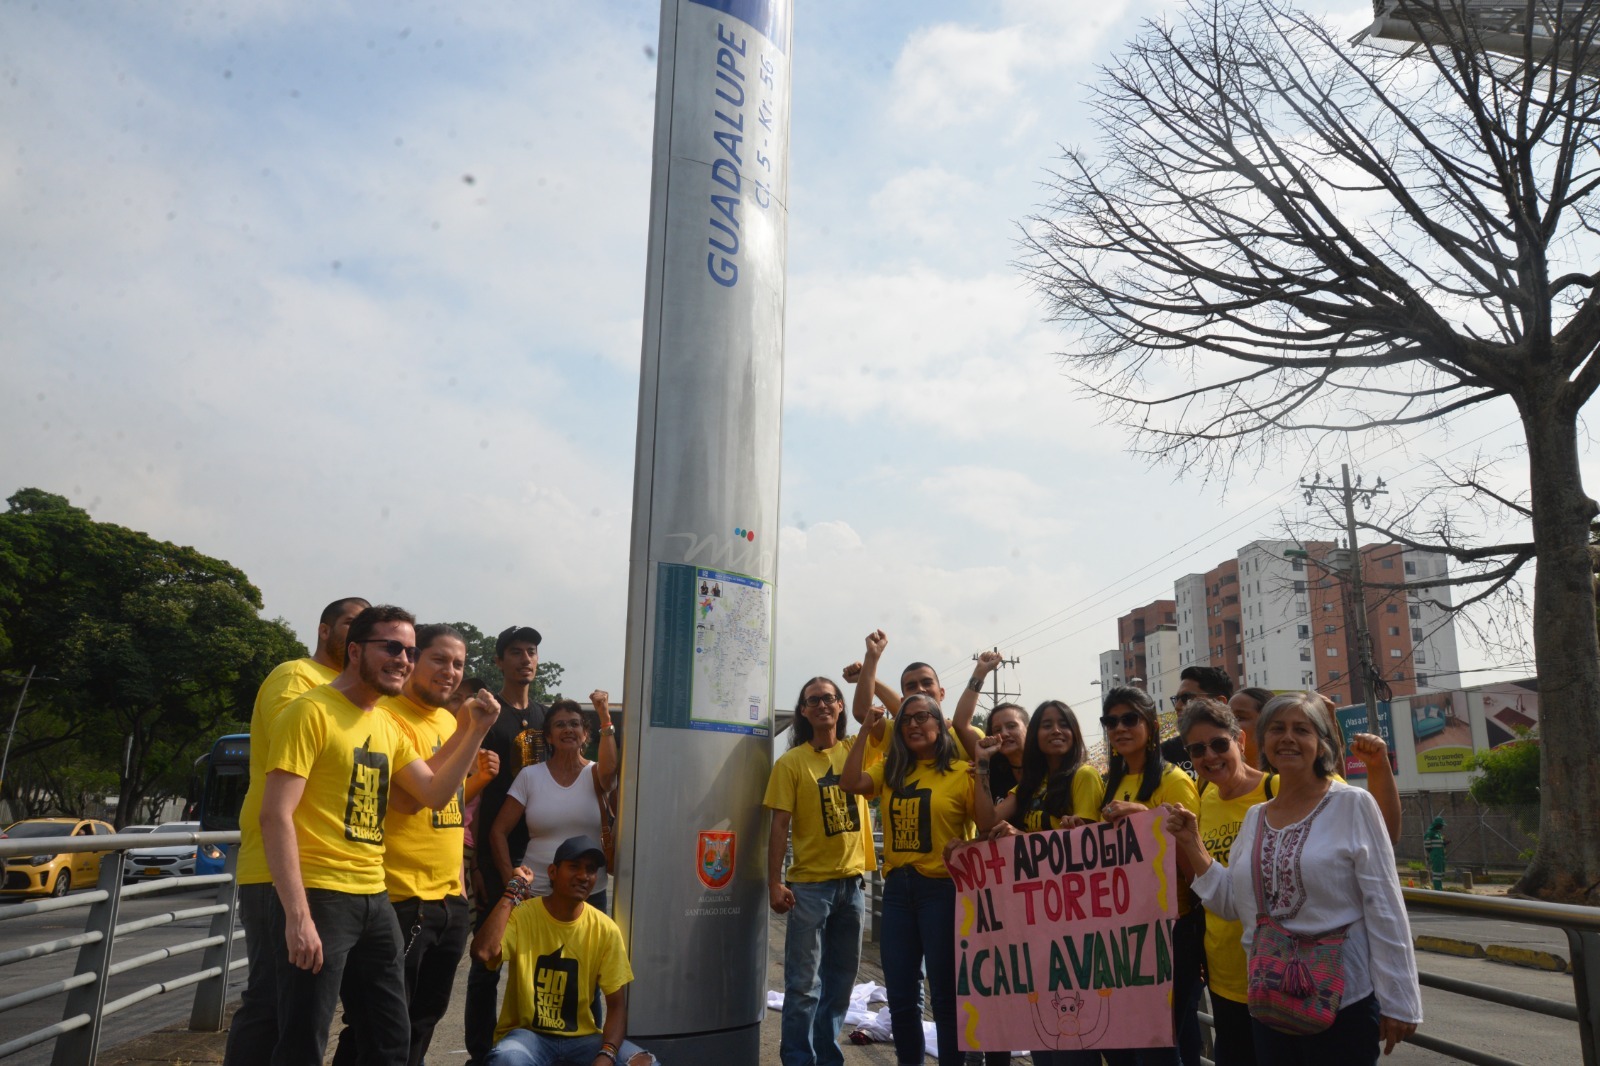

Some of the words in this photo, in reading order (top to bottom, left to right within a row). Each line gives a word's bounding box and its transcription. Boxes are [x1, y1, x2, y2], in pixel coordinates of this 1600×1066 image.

[759, 54, 774, 91] 56
[758, 100, 773, 133] Kr.
[707, 22, 747, 288] GUADALUPE
[756, 150, 771, 173] 5
[355, 763, 380, 798] YO
[352, 795, 378, 816] SOY
[892, 797, 920, 819] YO
[895, 818, 919, 831] SOY
[896, 830, 919, 841] ANTI
[1013, 817, 1144, 881] APOLOGÍA
[1203, 834, 1238, 851] OLO
[684, 908, 719, 917] SANTIAGO
[720, 907, 728, 915] DE
[728, 906, 741, 915] CALI
[977, 888, 1004, 933] AL
[1012, 867, 1131, 925] TOREO
[956, 939, 1035, 997] ¡CALI
[537, 967, 568, 996] YO
[537, 991, 564, 1008] SOY
[537, 1005, 562, 1019] ANTI
